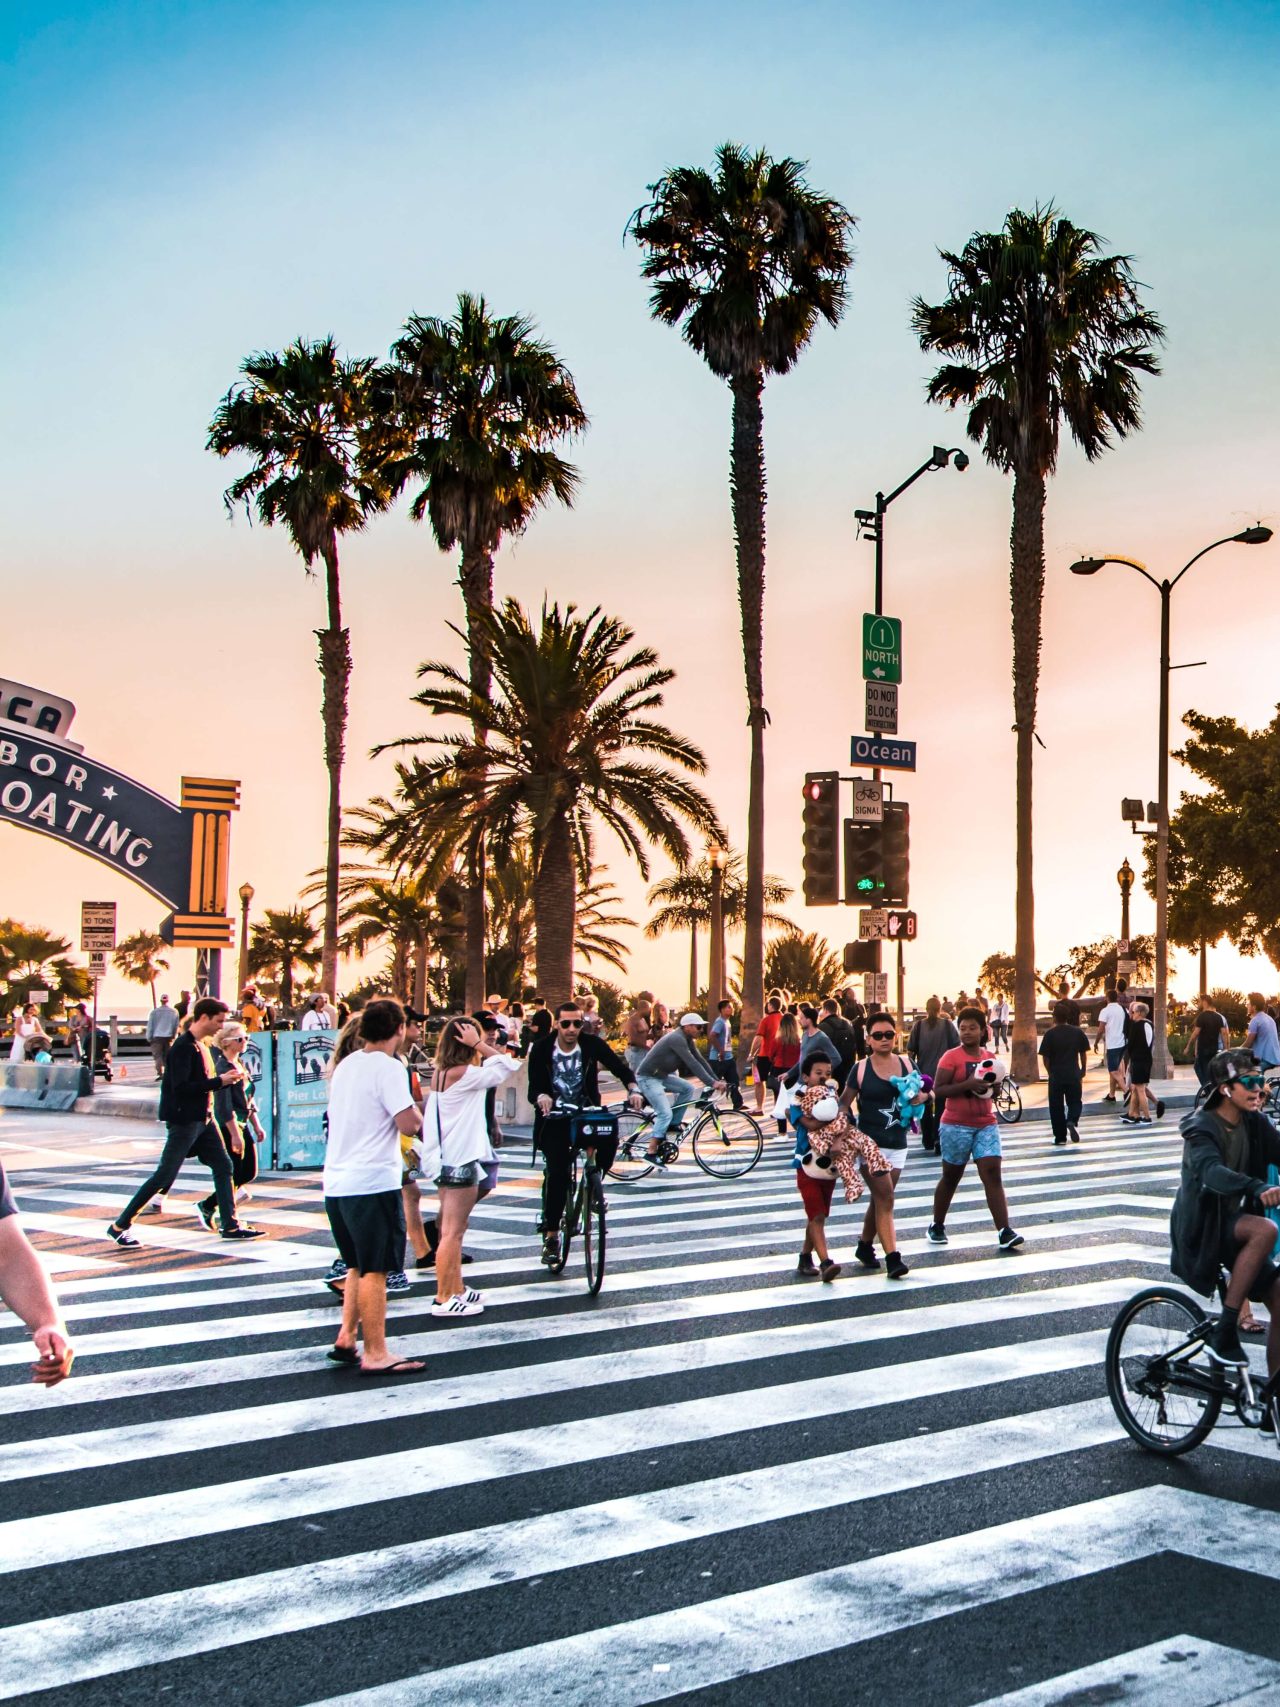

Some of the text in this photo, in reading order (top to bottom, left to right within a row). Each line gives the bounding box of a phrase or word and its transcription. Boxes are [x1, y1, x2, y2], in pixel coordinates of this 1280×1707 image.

[880, 628, 885, 644] 1
[865, 649, 899, 665] NORTH
[867, 688, 896, 703] DO NOT
[0, 691, 61, 734] CA
[867, 704, 896, 719] BLOCK
[856, 740, 912, 762] Ocean
[0, 740, 88, 792] BOR
[855, 806, 881, 815] SIGNAL
[2, 781, 153, 867] OATING
[860, 925, 871, 937] OK
[92, 953, 103, 961] NO
[288, 1090, 309, 1101] Pier
